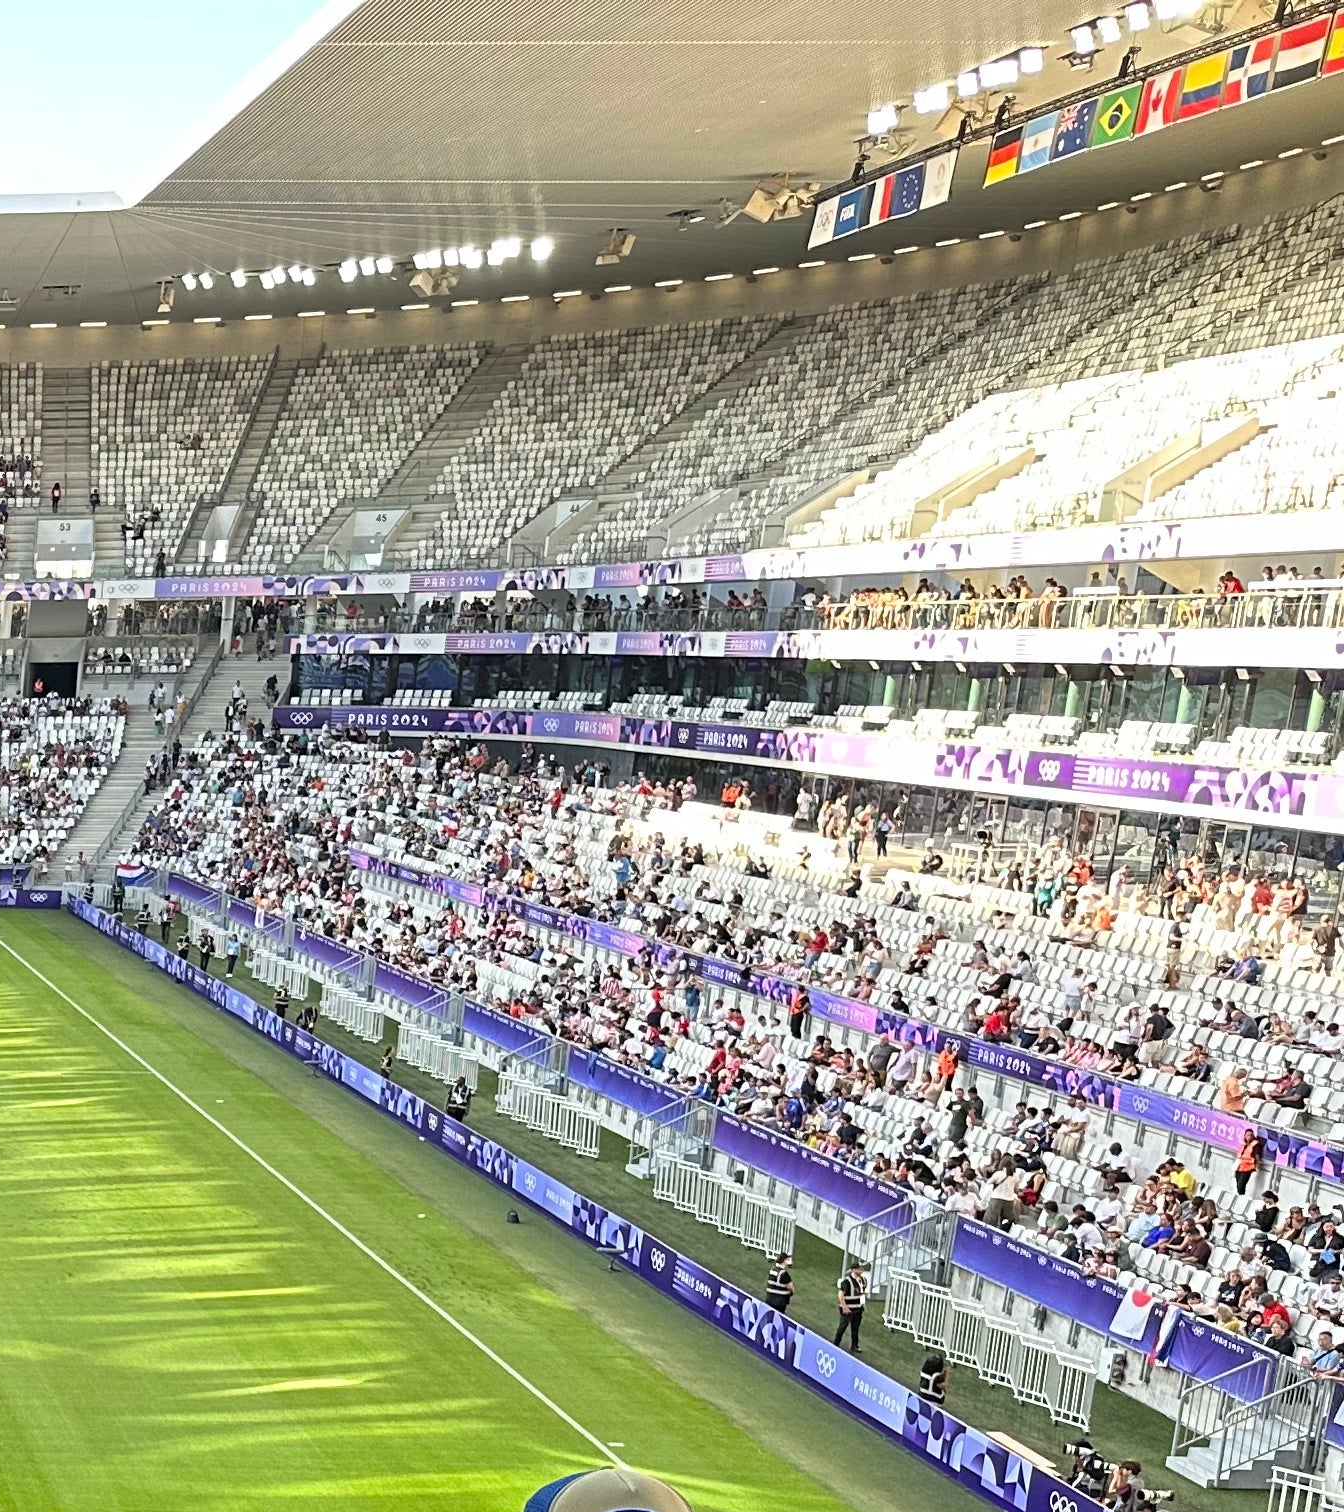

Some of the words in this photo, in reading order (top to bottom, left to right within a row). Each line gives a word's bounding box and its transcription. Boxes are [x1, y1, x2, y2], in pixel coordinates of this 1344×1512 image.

[375, 513, 388, 523] 45
[569, 504, 581, 514] 44
[171, 581, 210, 593] PARIS
[212, 580, 248, 593] 2024
[424, 577, 457, 588] PARIS
[458, 576, 486, 587] 2024
[457, 638, 487, 649] PARIS
[489, 637, 518, 649] 2024
[347, 712, 388, 725] PARIS
[391, 713, 430, 726] 2024
[703, 731, 726, 747] PARIS
[726, 733, 749, 750] 2024
[1088, 765, 1129, 788] PARIS
[1131, 768, 1171, 793] 2024
[707, 964, 724, 982] PARIS
[723, 969, 742, 985] 2024
[977, 1047, 1004, 1069] PARIS
[1006, 1055, 1031, 1076] 2024
[1173, 1108, 1208, 1132] PARIS
[677, 1268, 696, 1288] PARIS
[695, 1280, 712, 1300] 2024
[853, 1376, 878, 1401] PARIS
[878, 1392, 902, 1415] 2024
